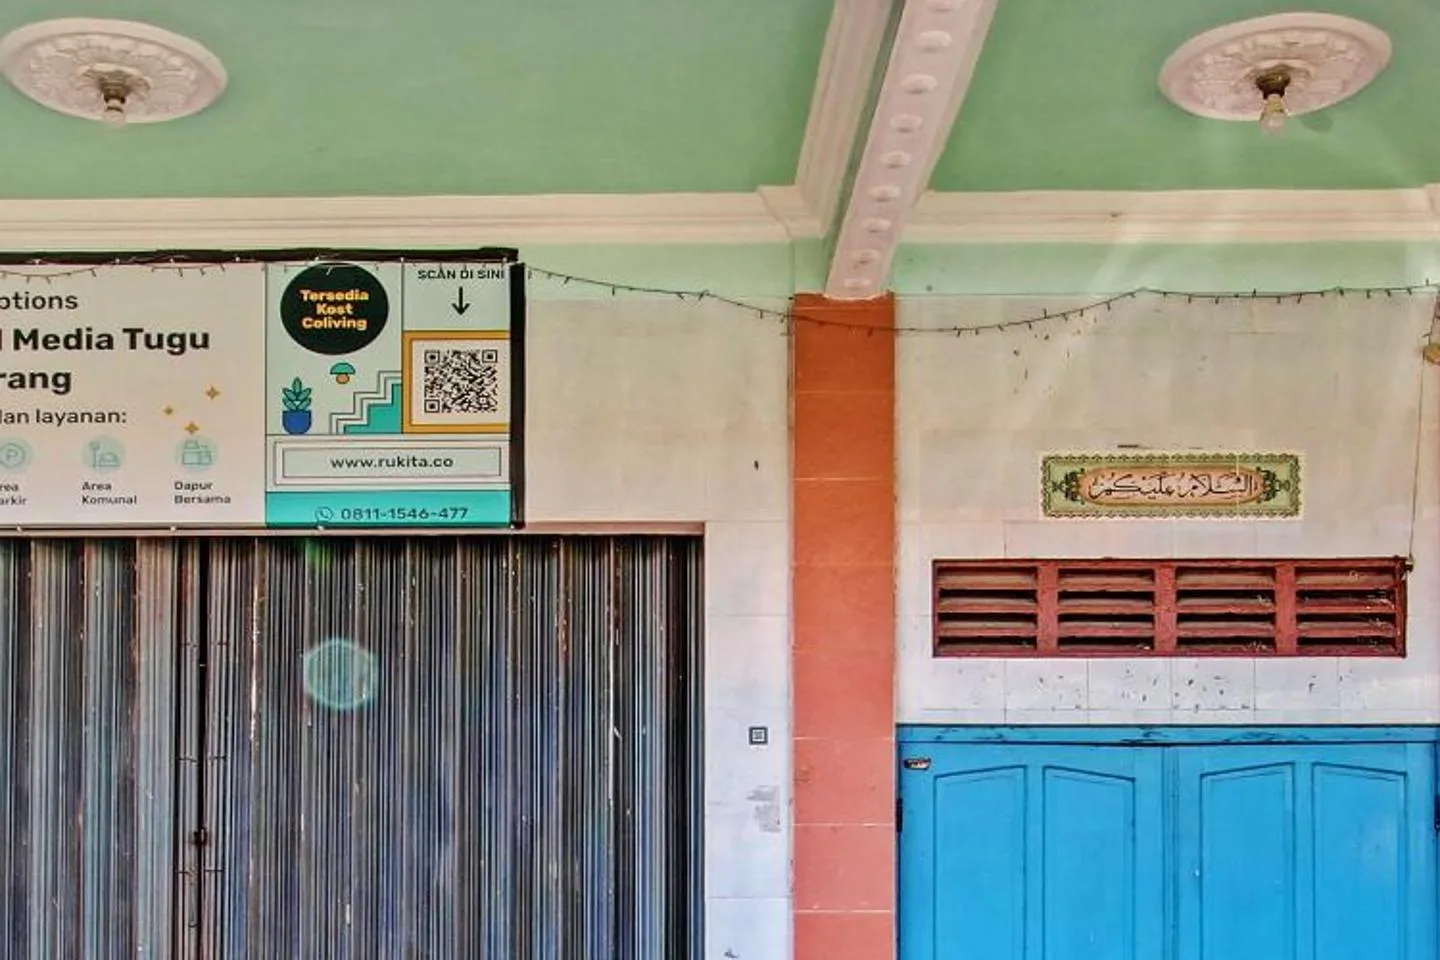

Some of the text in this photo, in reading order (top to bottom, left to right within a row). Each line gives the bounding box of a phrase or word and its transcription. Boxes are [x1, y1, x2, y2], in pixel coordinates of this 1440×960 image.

[418, 269, 505, 280] SCAN DI SINI
[300, 289, 370, 301] Tersedia
[316, 303, 354, 315] Kost
[301, 317, 368, 331] Coliving
[13, 327, 114, 350] Media
[123, 328, 209, 356] Tugu
[35, 409, 127, 427] layanan:
[330, 456, 454, 469] www.rukita.co
[82, 482, 113, 491] Area
[174, 481, 213, 492] Dapur
[82, 495, 138, 505] Komunal
[174, 495, 232, 505] Bersama
[341, 507, 468, 520] 0811-1546-477
